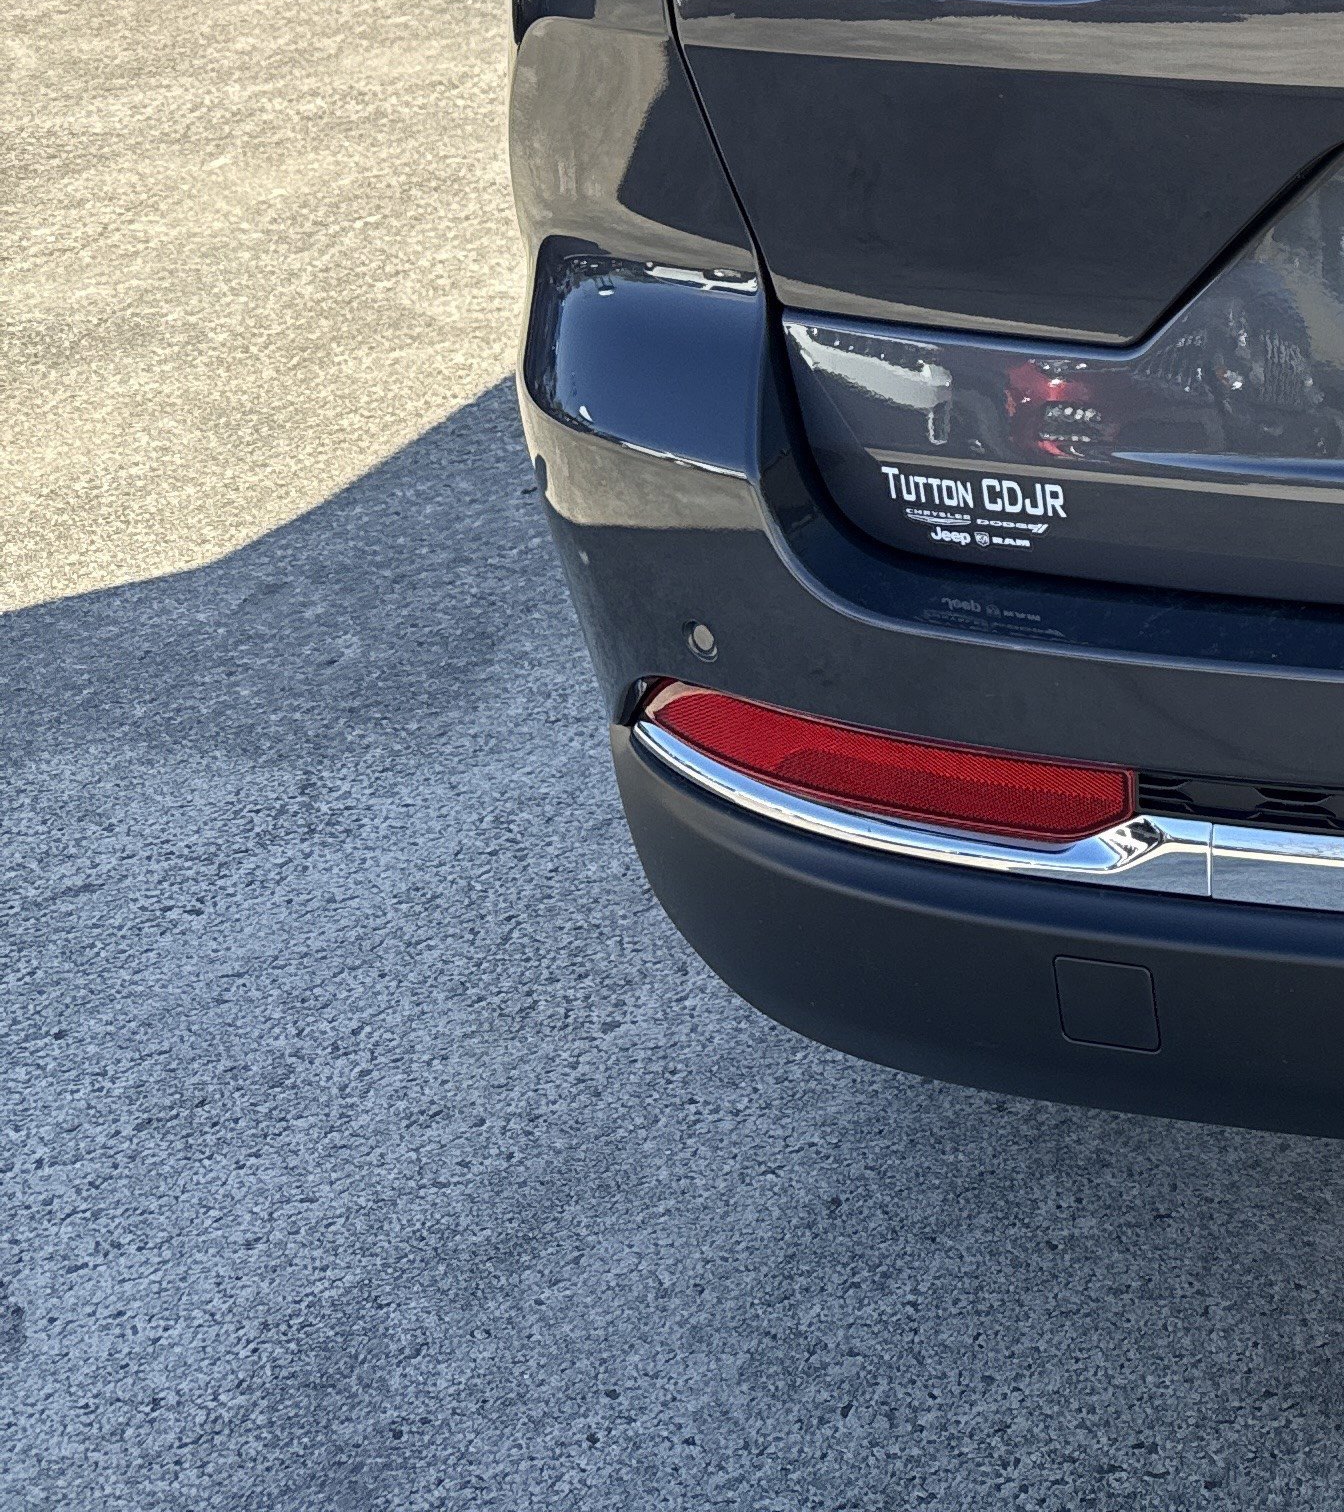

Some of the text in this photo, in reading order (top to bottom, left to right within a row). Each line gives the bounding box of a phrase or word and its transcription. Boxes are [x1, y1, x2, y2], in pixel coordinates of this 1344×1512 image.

[881, 466, 1067, 518] TUTTON CDJR
[905, 507, 972, 520] CHRYSLER
[930, 526, 1031, 548] Jeep RAM
